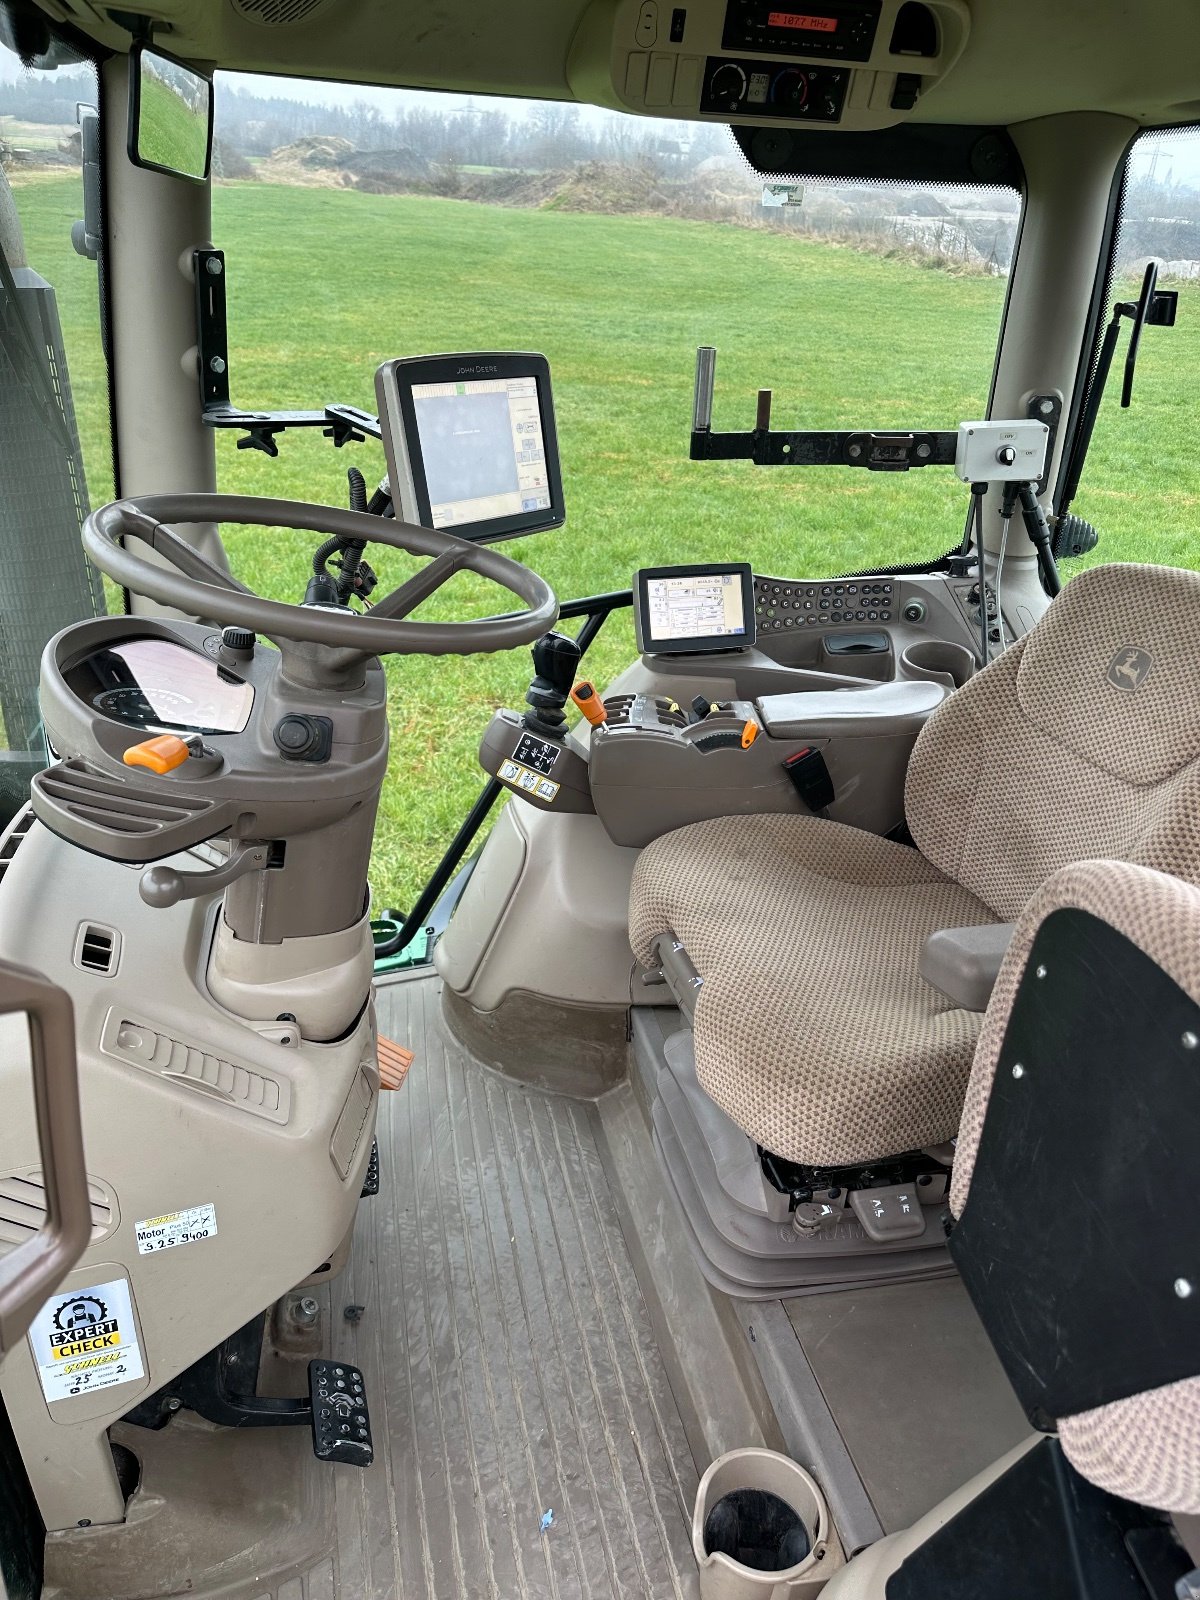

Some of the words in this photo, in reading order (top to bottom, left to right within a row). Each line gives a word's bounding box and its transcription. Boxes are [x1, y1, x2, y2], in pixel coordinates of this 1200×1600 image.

[810, 18, 828, 29] MHz
[456, 366, 475, 375] JOHN
[475, 365, 498, 373] DEERE
[137, 1228, 165, 1241] Motor
[50, 1319, 116, 1347] EXPERT
[59, 1334, 114, 1357] CHECK
[115, 1364, 127, 1374] 2
[75, 1373, 92, 1386] 25
[99, 1378, 120, 1386] DEERE
